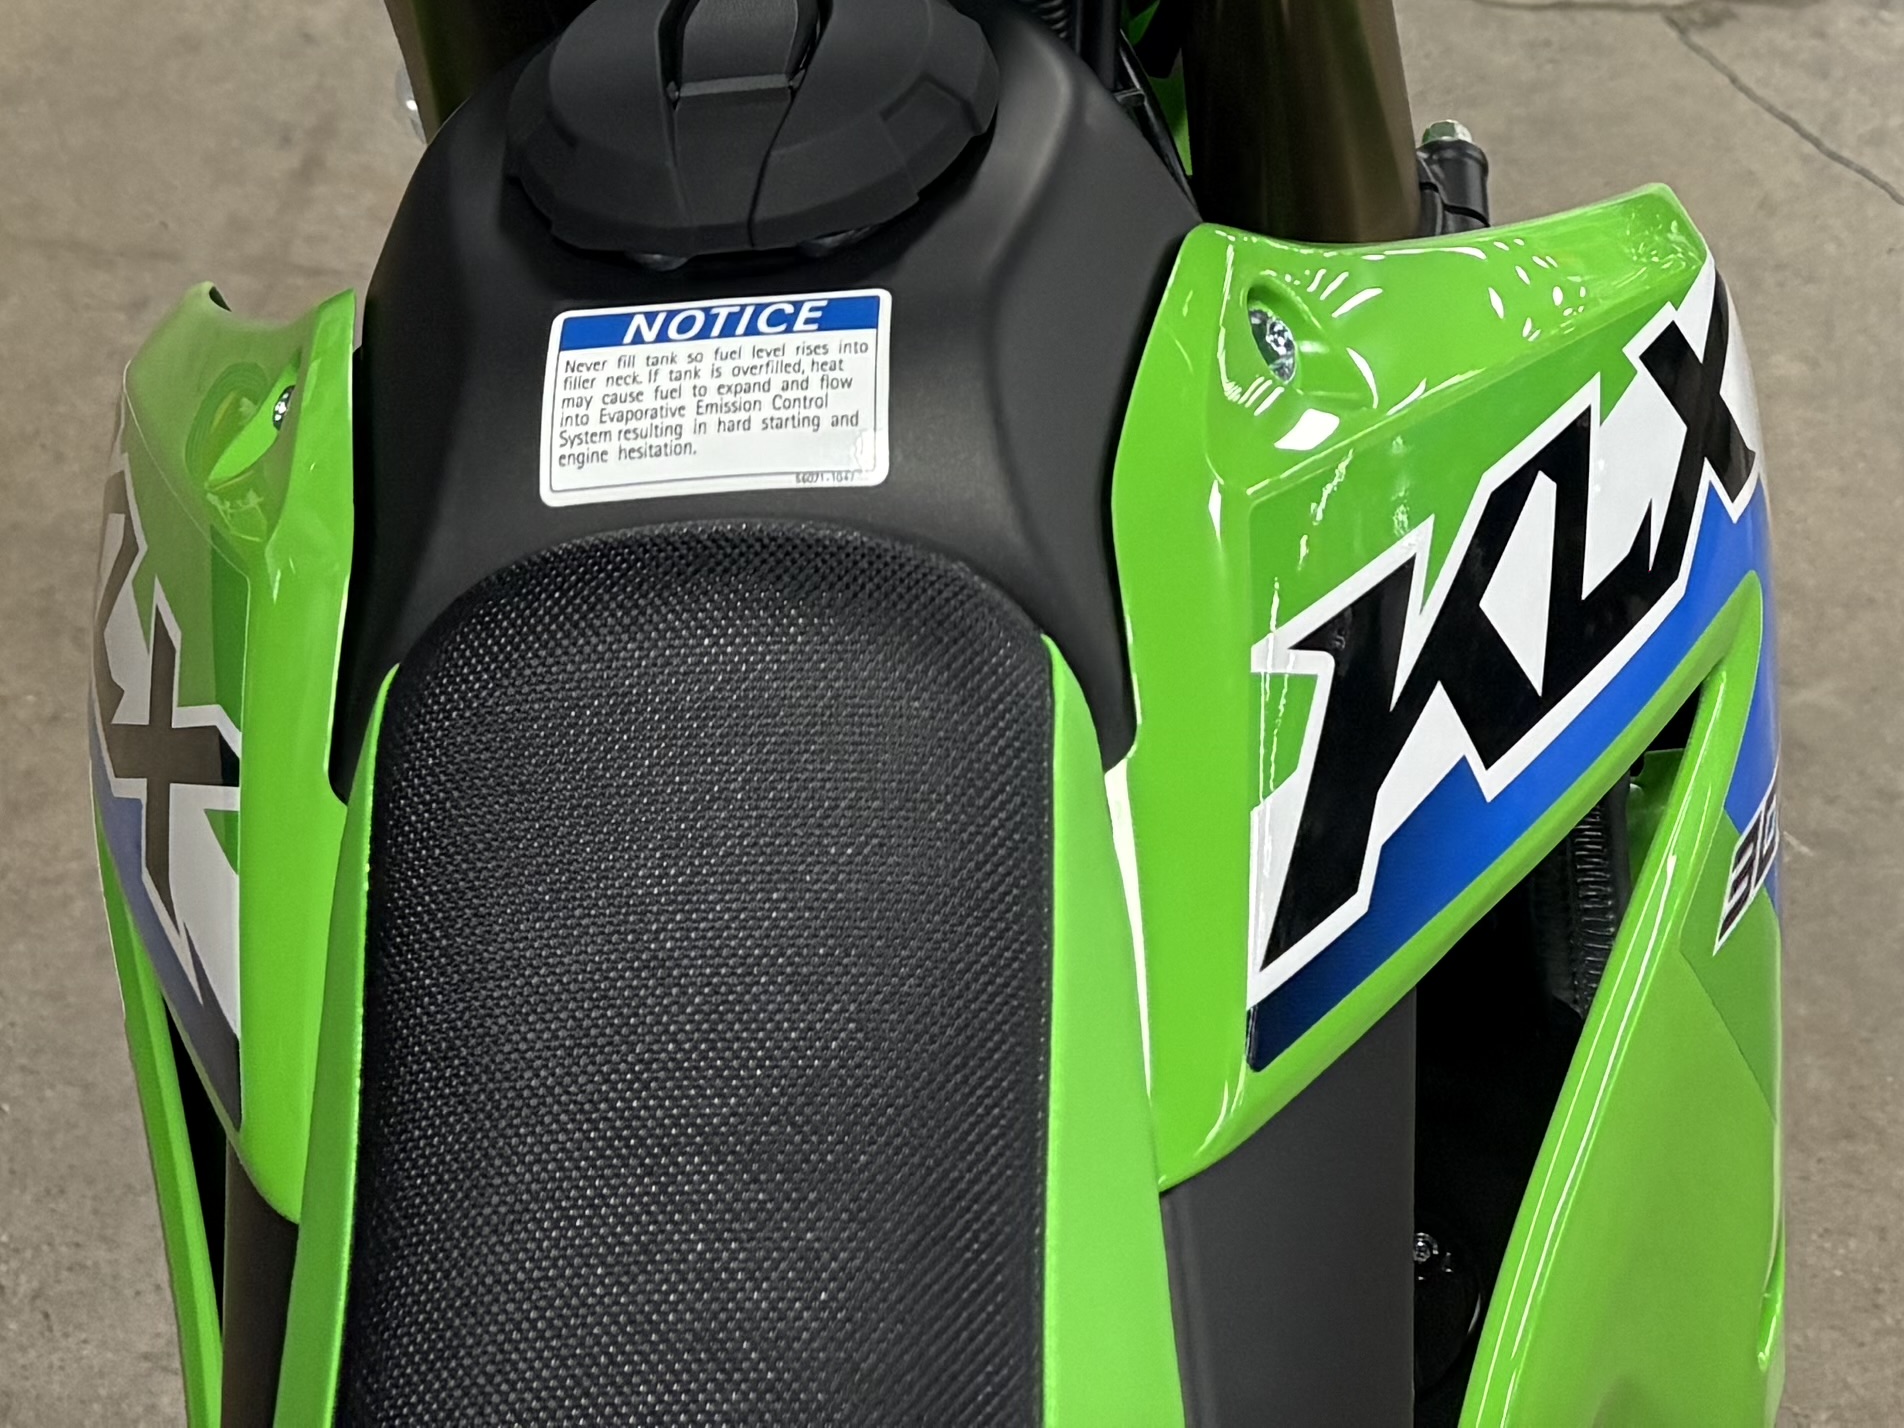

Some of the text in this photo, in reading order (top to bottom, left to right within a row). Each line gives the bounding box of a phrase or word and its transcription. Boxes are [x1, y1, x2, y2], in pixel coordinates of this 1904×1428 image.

[622, 299, 829, 345] NOTICE
[563, 358, 845, 391] filler neck. If tank is overfilled, heat
[564, 339, 869, 374] Never fill tank so fuel level rises into
[561, 374, 853, 411] may cause fuel to expand and flow
[559, 394, 829, 428] into Evaporative Emission Control
[558, 410, 860, 449] System resulting in hard starting and
[558, 441, 698, 469] engine hesitation.
[1259, 266, 1758, 974] KLX
